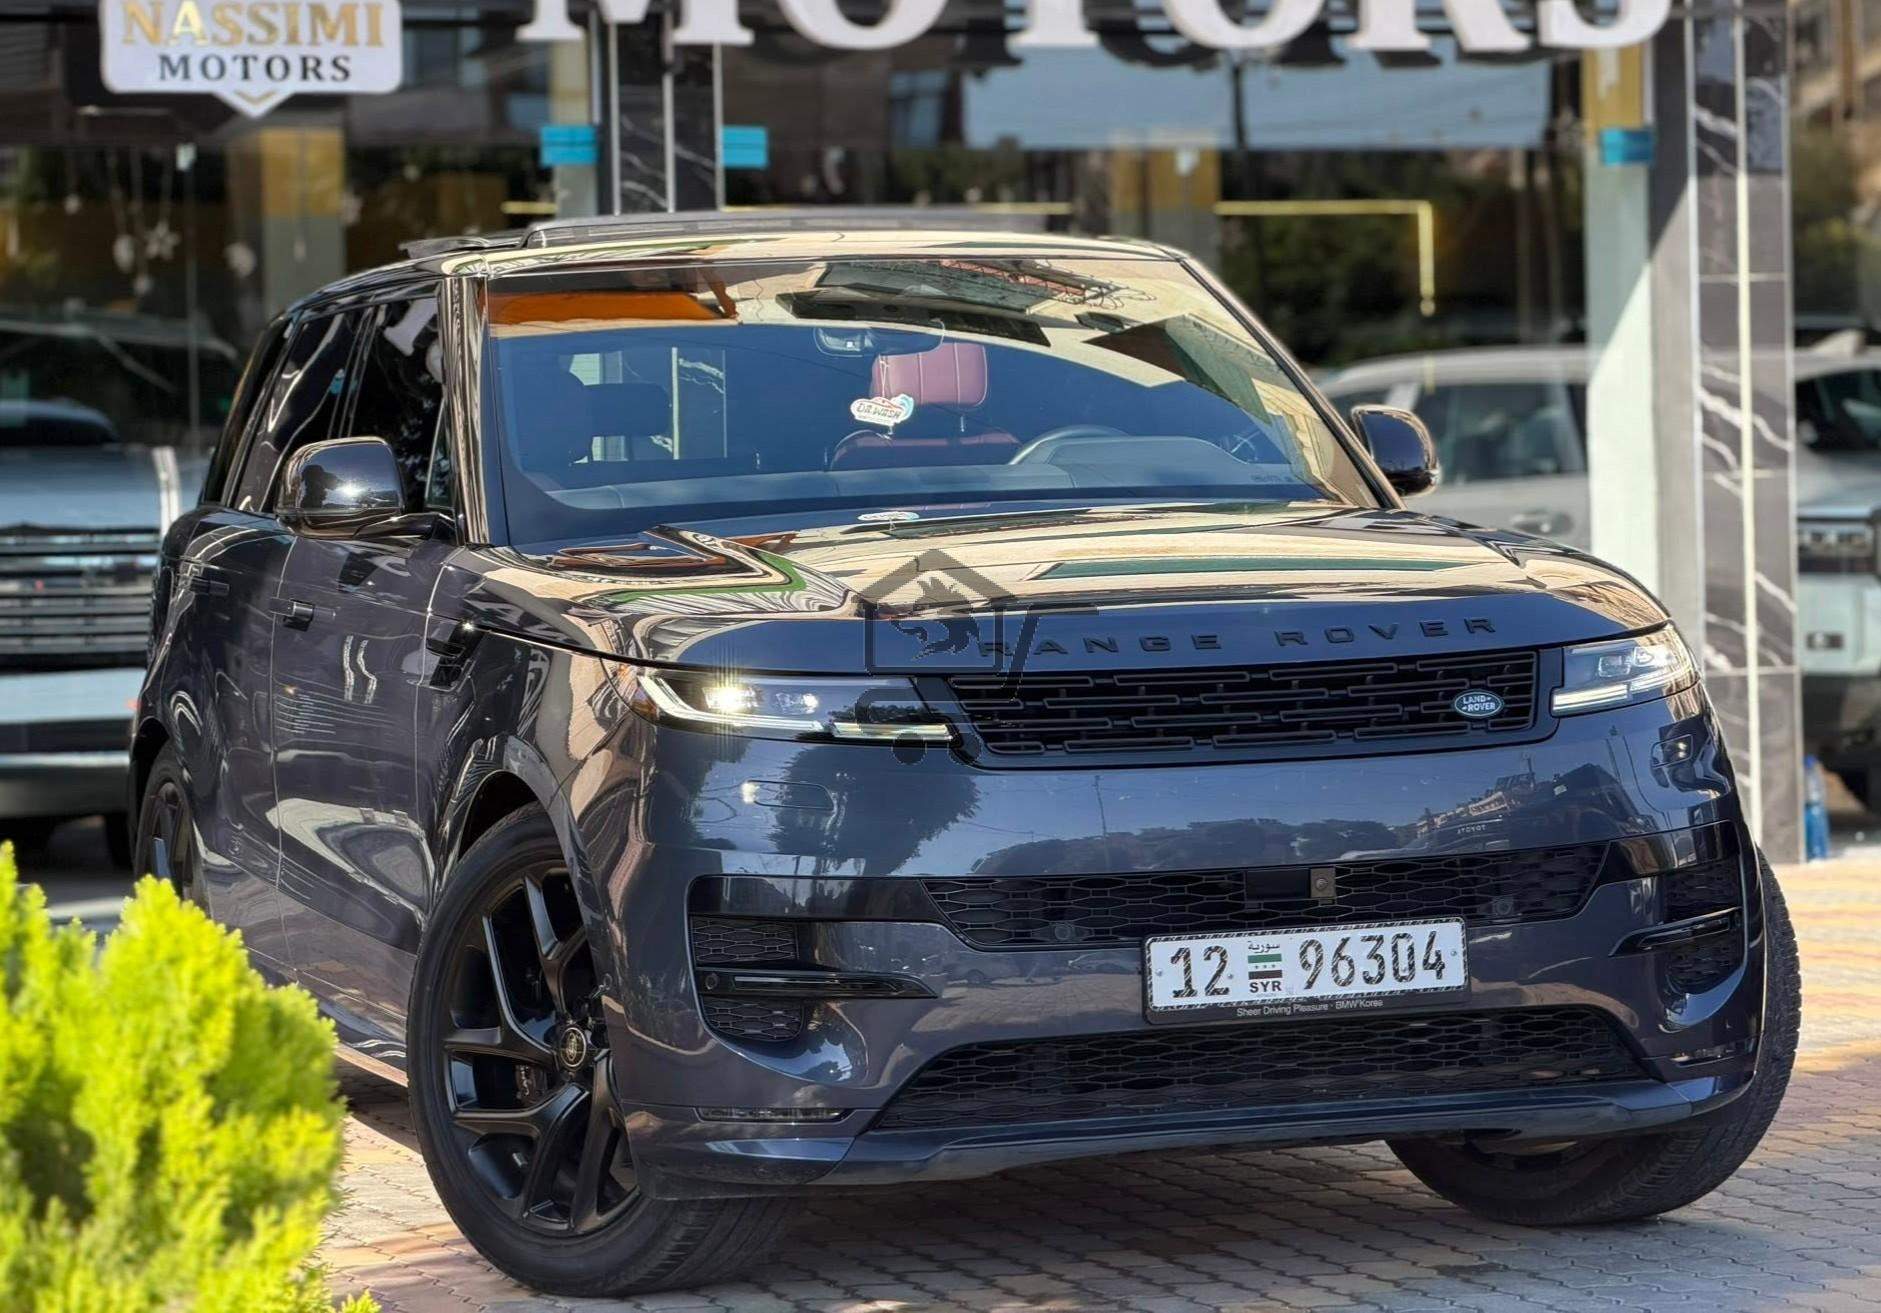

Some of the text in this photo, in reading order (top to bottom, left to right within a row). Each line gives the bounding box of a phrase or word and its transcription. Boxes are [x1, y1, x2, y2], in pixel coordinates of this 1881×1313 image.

[122, 1, 384, 46] NASSIMI
[158, 54, 352, 82] MOTORS
[979, 618, 1496, 658] RANGE ROVER
[1462, 695, 1486, 704] LAND
[1467, 702, 1496, 712] ROVER
[1247, 940, 1280, 953] سورية
[1170, 930, 1446, 998] 12 96304
[1249, 981, 1282, 993] SYR
[1236, 999, 1384, 1017] Sheer Driving Pleasure BMW Korea
